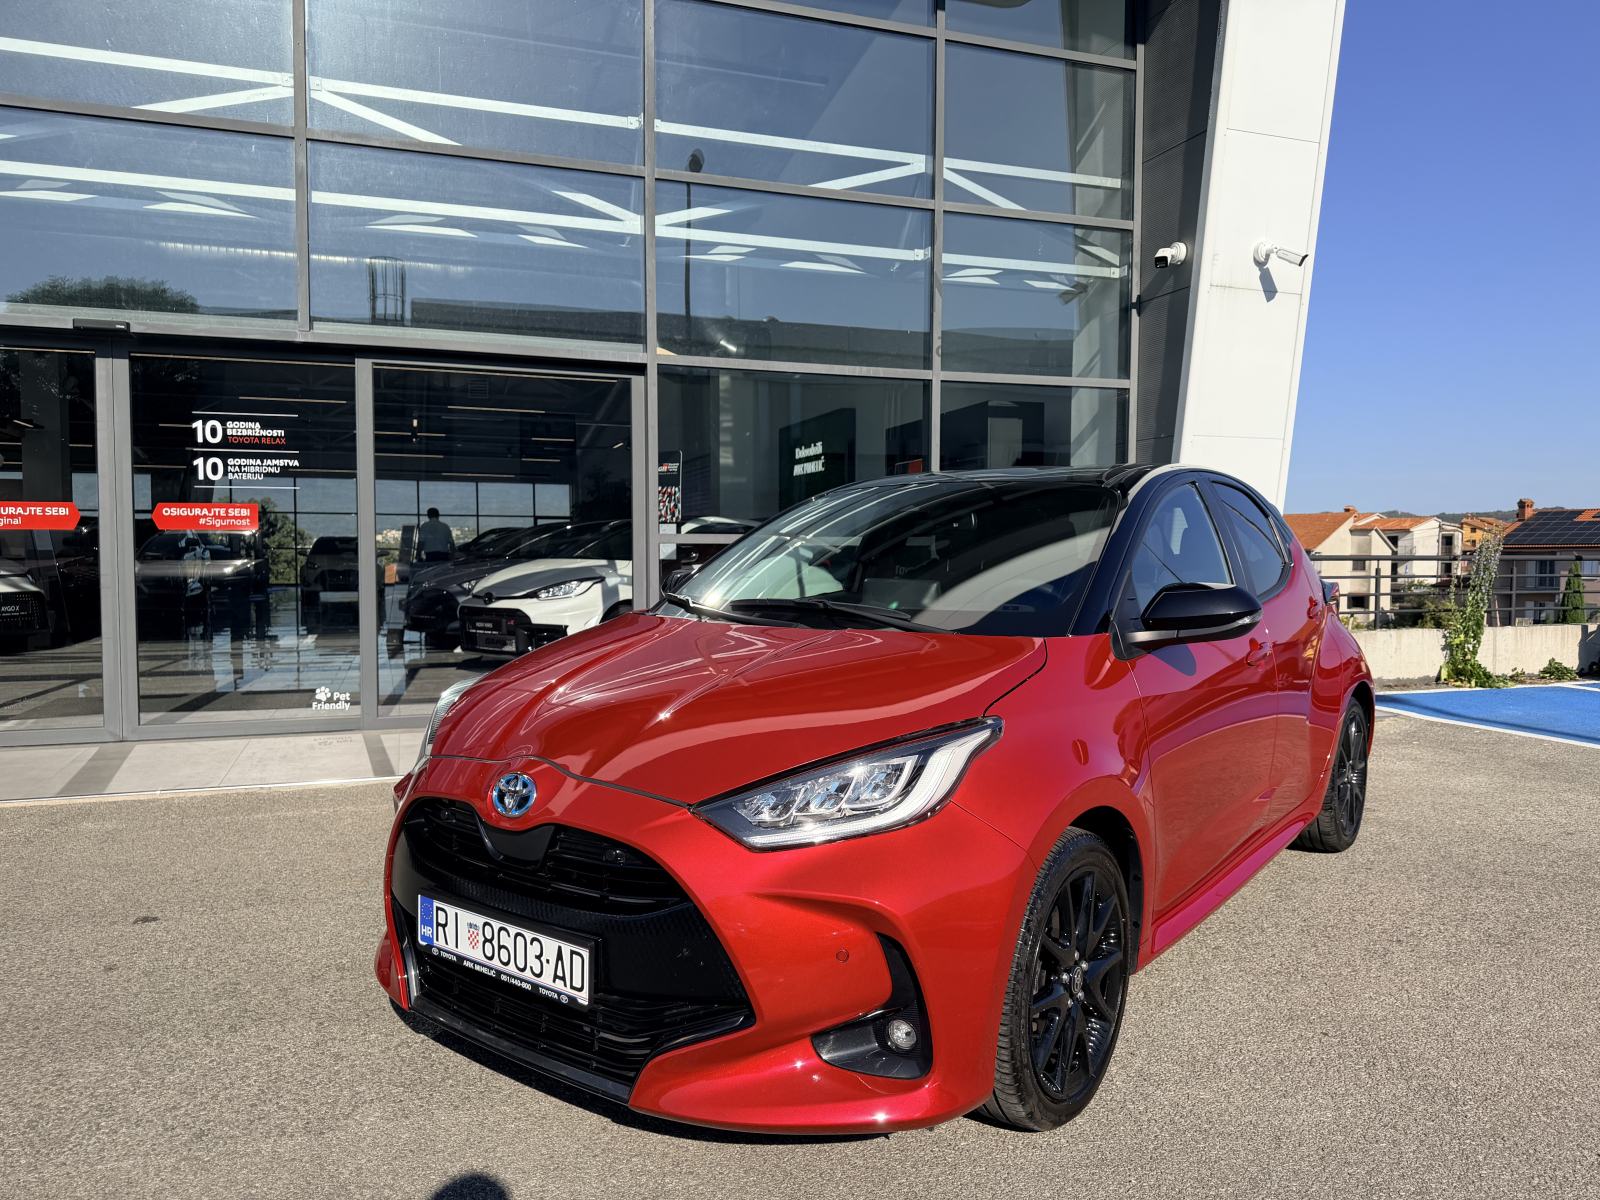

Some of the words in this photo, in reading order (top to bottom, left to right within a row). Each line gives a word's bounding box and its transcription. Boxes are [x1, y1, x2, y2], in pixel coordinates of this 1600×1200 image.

[226, 421, 261, 429] GODINA
[192, 419, 223, 444] 10
[226, 427, 285, 437] BEZBRIŽNOSTI
[227, 436, 260, 444] TOYOTA
[261, 437, 287, 445] RELAX
[227, 458, 262, 466] GODINA
[262, 459, 300, 467] JAMSTVA
[193, 456, 224, 481] 10
[241, 466, 281, 474] HIBRIDNU
[45, 507, 69, 516] SEBI
[162, 507, 227, 517] OSIGURAJTE
[227, 508, 250, 517] SEBI
[199, 517, 251, 528] #Sigurnost
[333, 691, 351, 701] Pet
[312, 700, 351, 711] Friendly
[421, 923, 433, 938] HR
[435, 906, 459, 949] RI
[440, 951, 457, 962] TOYOTA
[462, 959, 475, 970] ARK
[474, 963, 496, 977] MIHELIĆ
[538, 986, 559, 1000] TOYOTA
